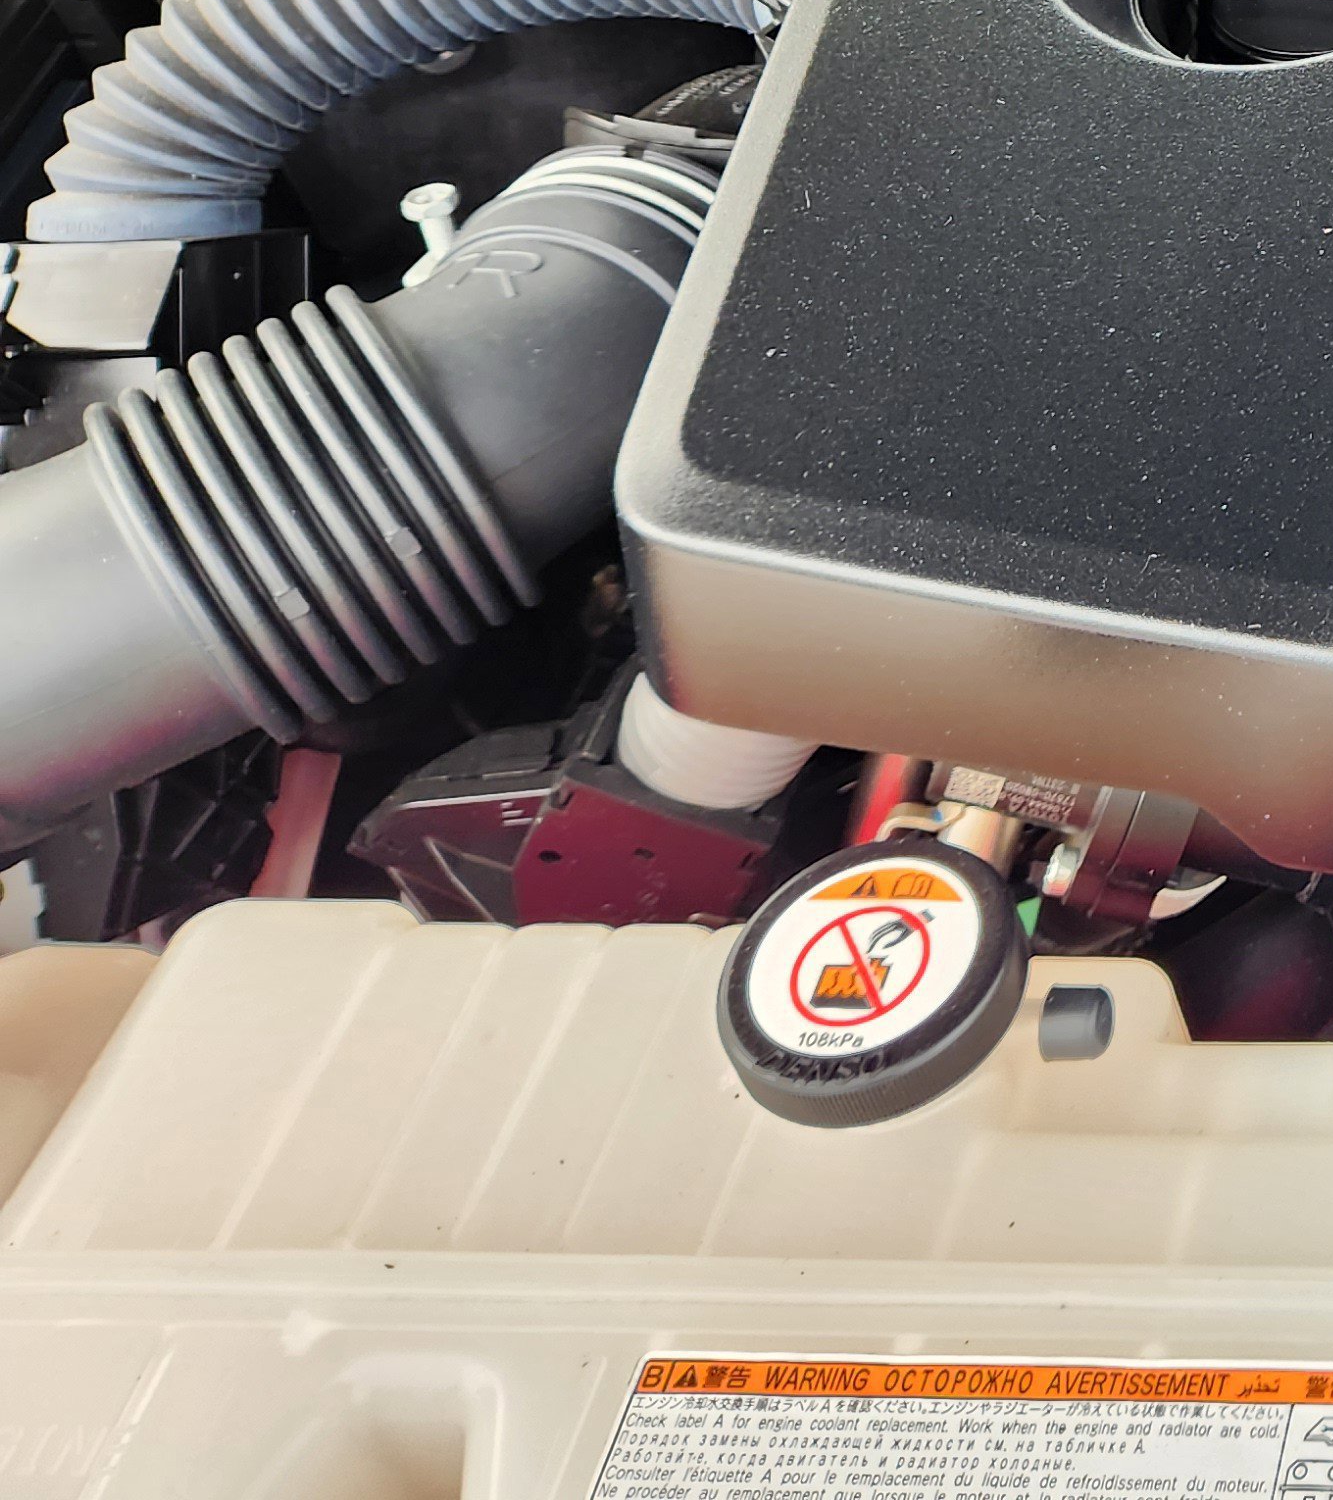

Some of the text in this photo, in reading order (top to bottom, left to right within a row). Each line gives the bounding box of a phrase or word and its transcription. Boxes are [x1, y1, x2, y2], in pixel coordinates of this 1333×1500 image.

[641, 1365, 663, 1389] B
[702, 1365, 752, 1390] 警告
[764, 1366, 871, 1392] WARNING
[884, 1368, 1034, 1394] ОСТОРОЖНО
[1045, 1371, 1231, 1398] AVERTISSEMENT
[625, 1413, 1281, 1439] Check label A for engine coolant replacement. Work when the engine and radiator are cold.
[618, 1430, 691, 1448] Порядок
[699, 1433, 761, 1448] замены
[768, 1434, 884, 1451] охлаждающей
[890, 1438, 976, 1452] жидкости
[1015, 1439, 1035, 1453] на
[1045, 1438, 1127, 1454] табличке
[717, 1452, 767, 1467] когда
[774, 1454, 869, 1468] двигатель
[878, 1455, 888, 1469] и
[895, 1456, 980, 1471] радиатор
[988, 1457, 1076, 1472] холодные.
[597, 1482, 618, 1499] Ne
[625, 1482, 692, 1500] procéder
[699, 1488, 719, 1500] au
[727, 1486, 826, 1500] remplacement
[605, 1464, 1268, 1493] Consulter l'étiquette A pour le remplacement du liquide de refroidissement du moteur.
